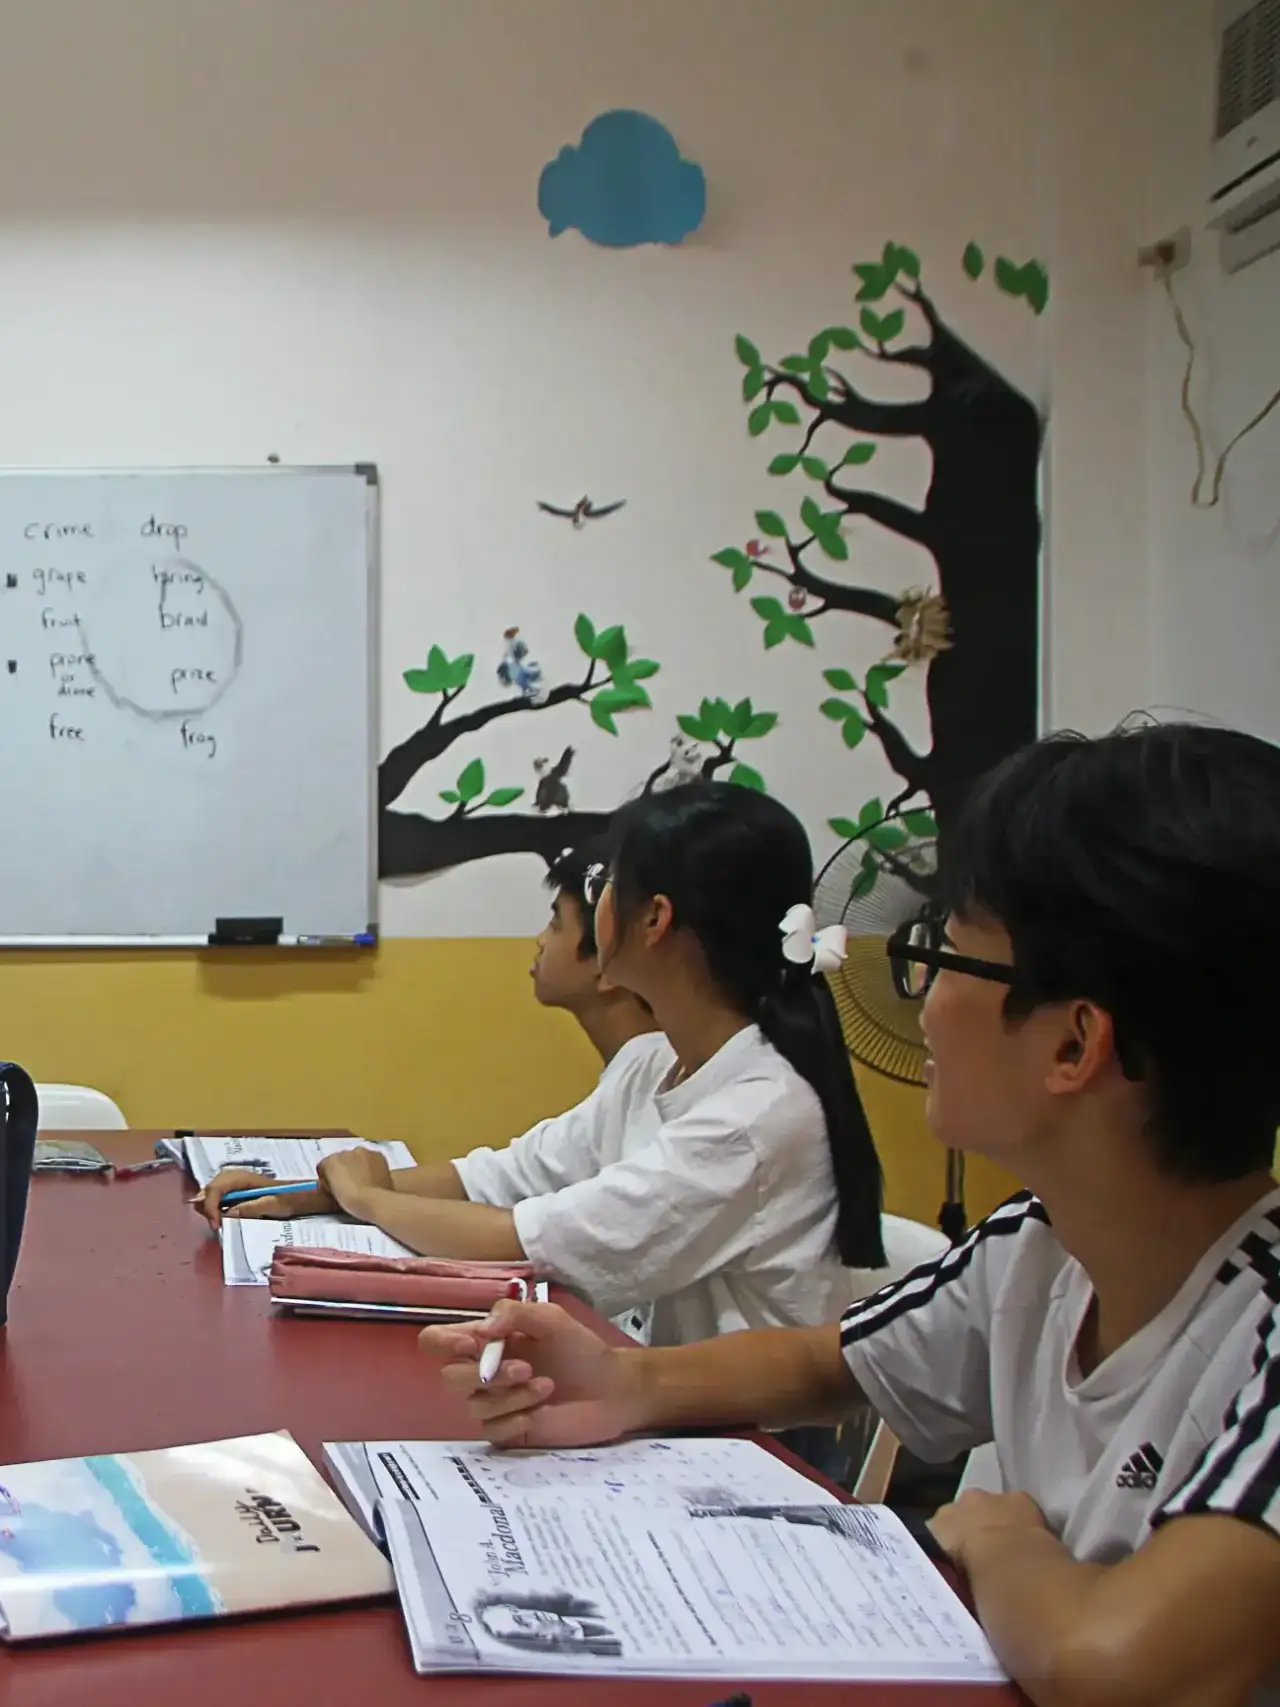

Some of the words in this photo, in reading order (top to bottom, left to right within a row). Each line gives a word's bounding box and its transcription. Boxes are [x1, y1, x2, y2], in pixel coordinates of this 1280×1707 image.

[23, 521, 95, 540] crime
[140, 513, 188, 551] drop
[32, 566, 87, 596] grape
[41, 606, 82, 630] fruit
[49, 711, 85, 742] free
[180, 718, 217, 759] frog
[233, 1499, 280, 1544] Daily
[244, 1487, 321, 1552] JURN
